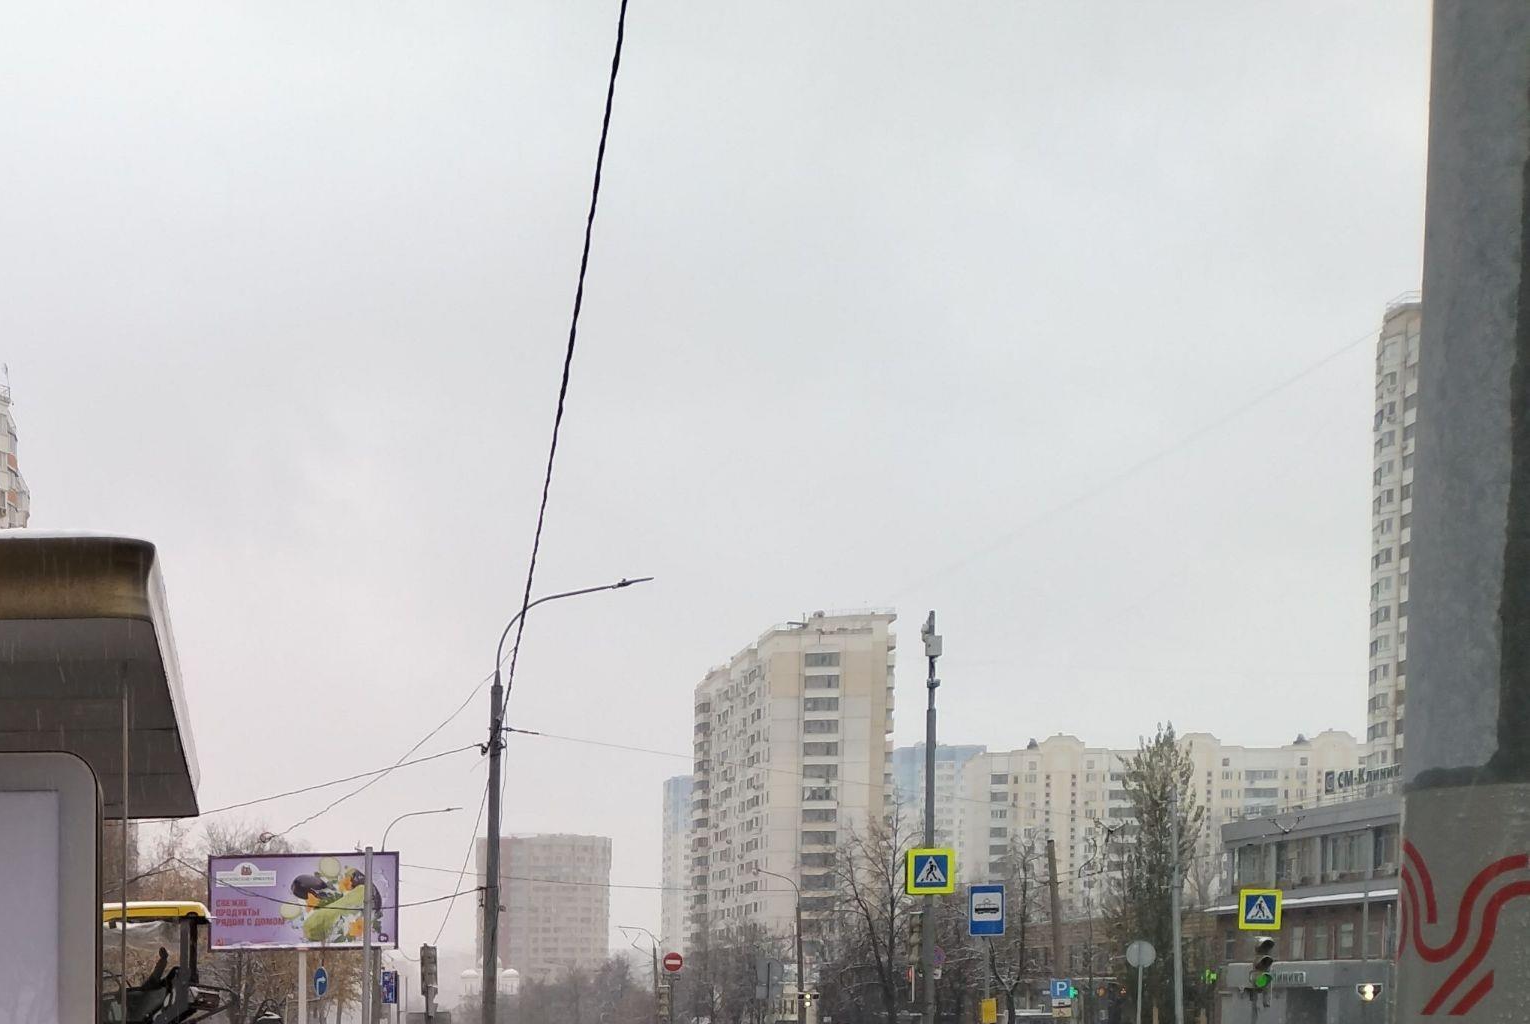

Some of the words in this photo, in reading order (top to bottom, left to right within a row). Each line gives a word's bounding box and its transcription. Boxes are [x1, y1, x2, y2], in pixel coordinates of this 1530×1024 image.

[215, 908, 260, 917] ПРОДУКТЫ
[215, 917, 245, 927] РЯДОМ
[254, 917, 285, 926] ДОМОМ
